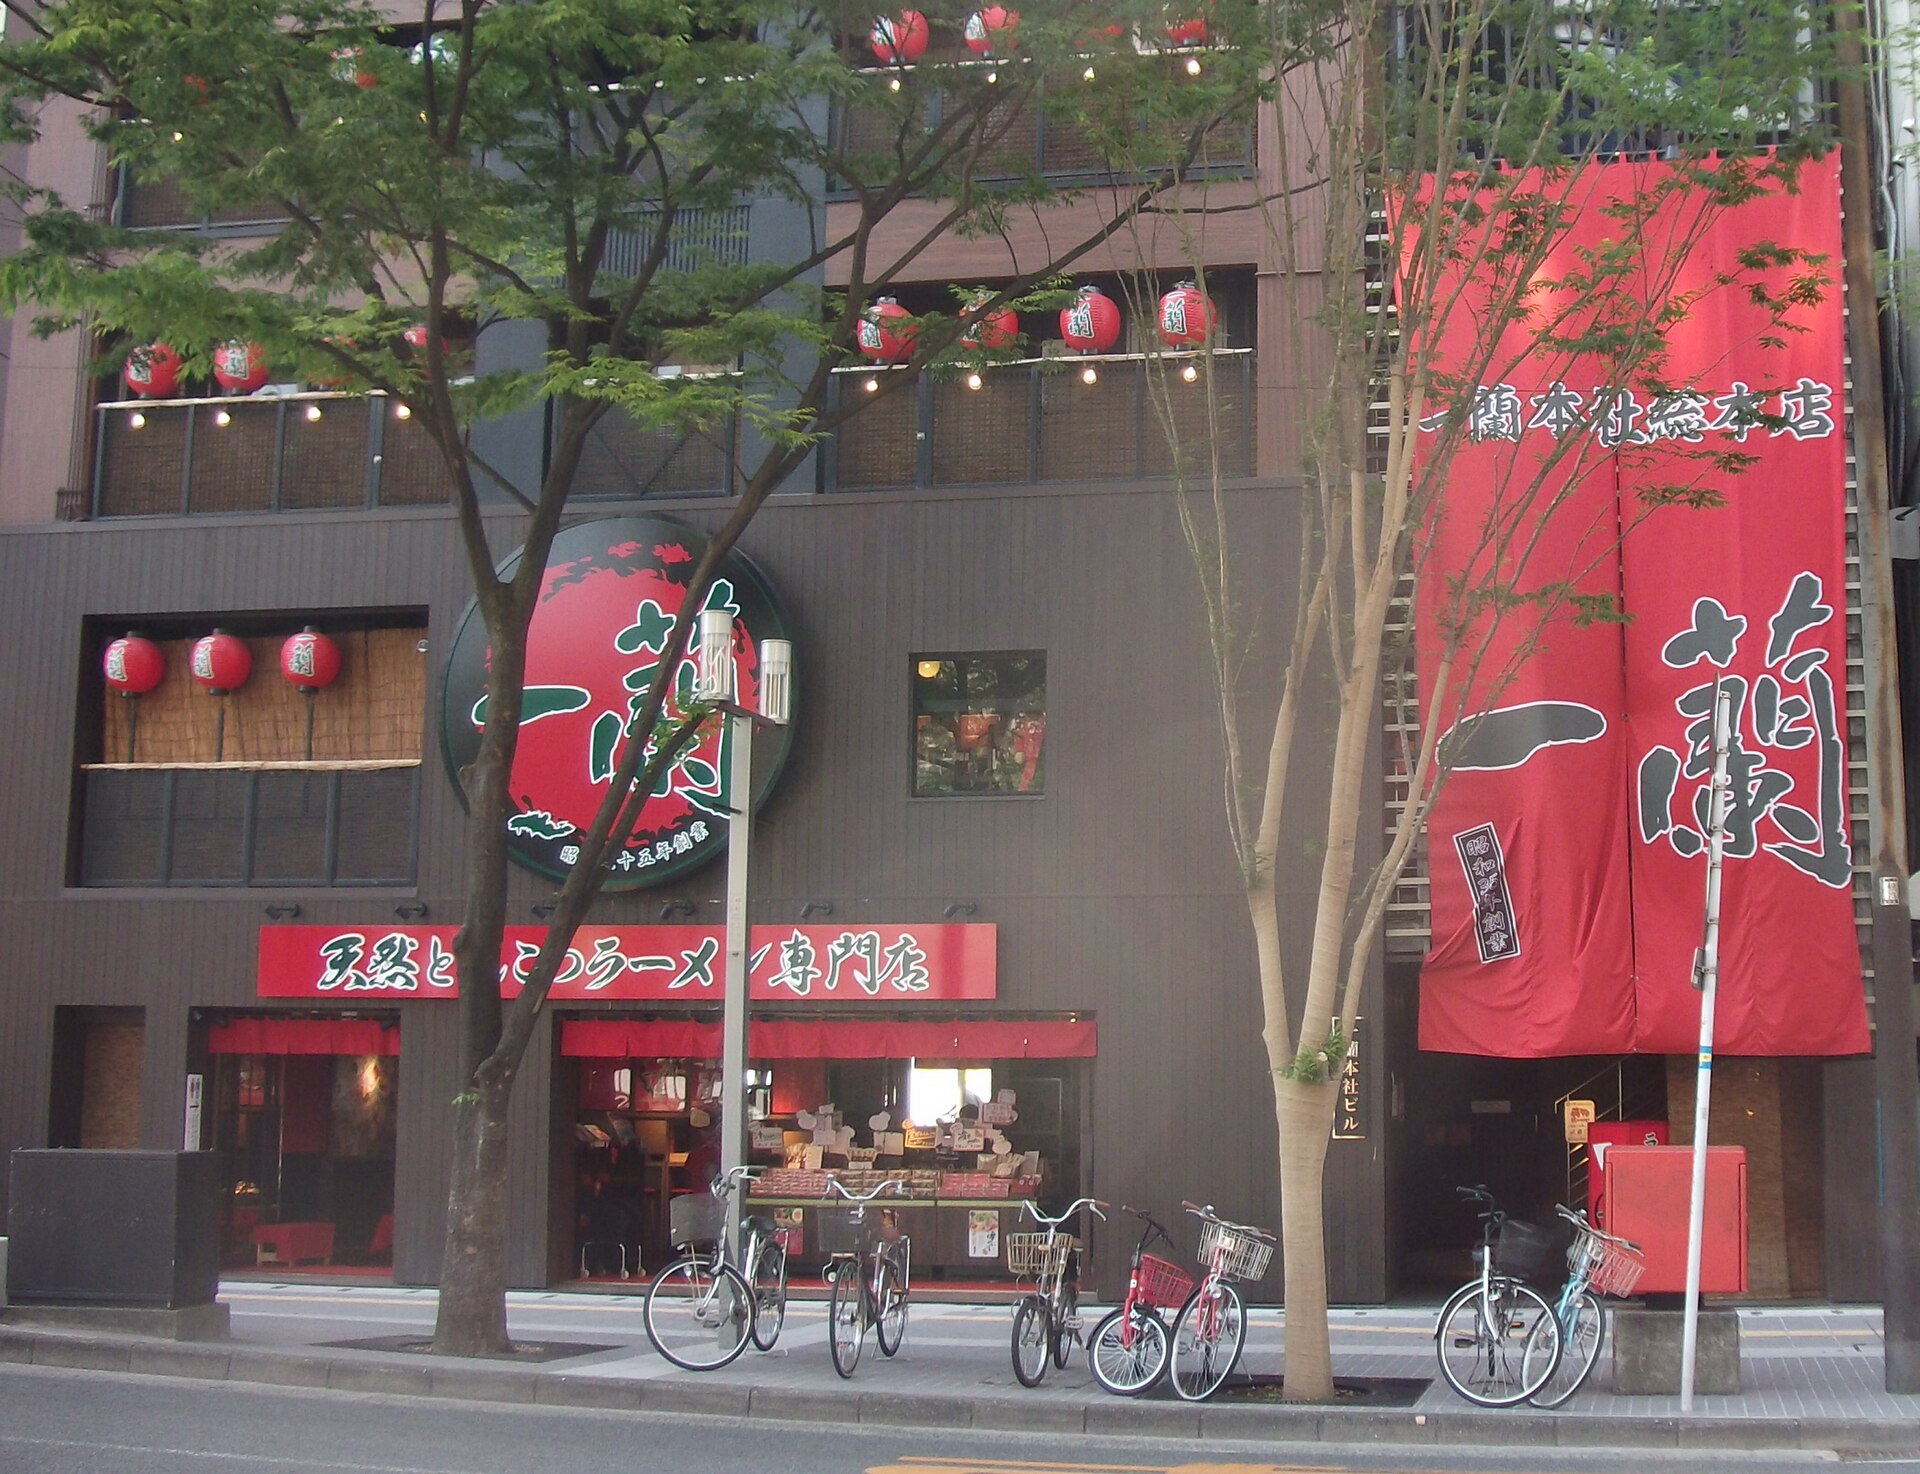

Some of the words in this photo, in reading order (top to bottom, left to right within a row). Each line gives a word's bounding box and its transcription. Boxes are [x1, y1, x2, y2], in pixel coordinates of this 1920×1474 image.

[1434, 571, 1852, 889] 一蘭
[559, 821, 709, 872] 昭十五年創業
